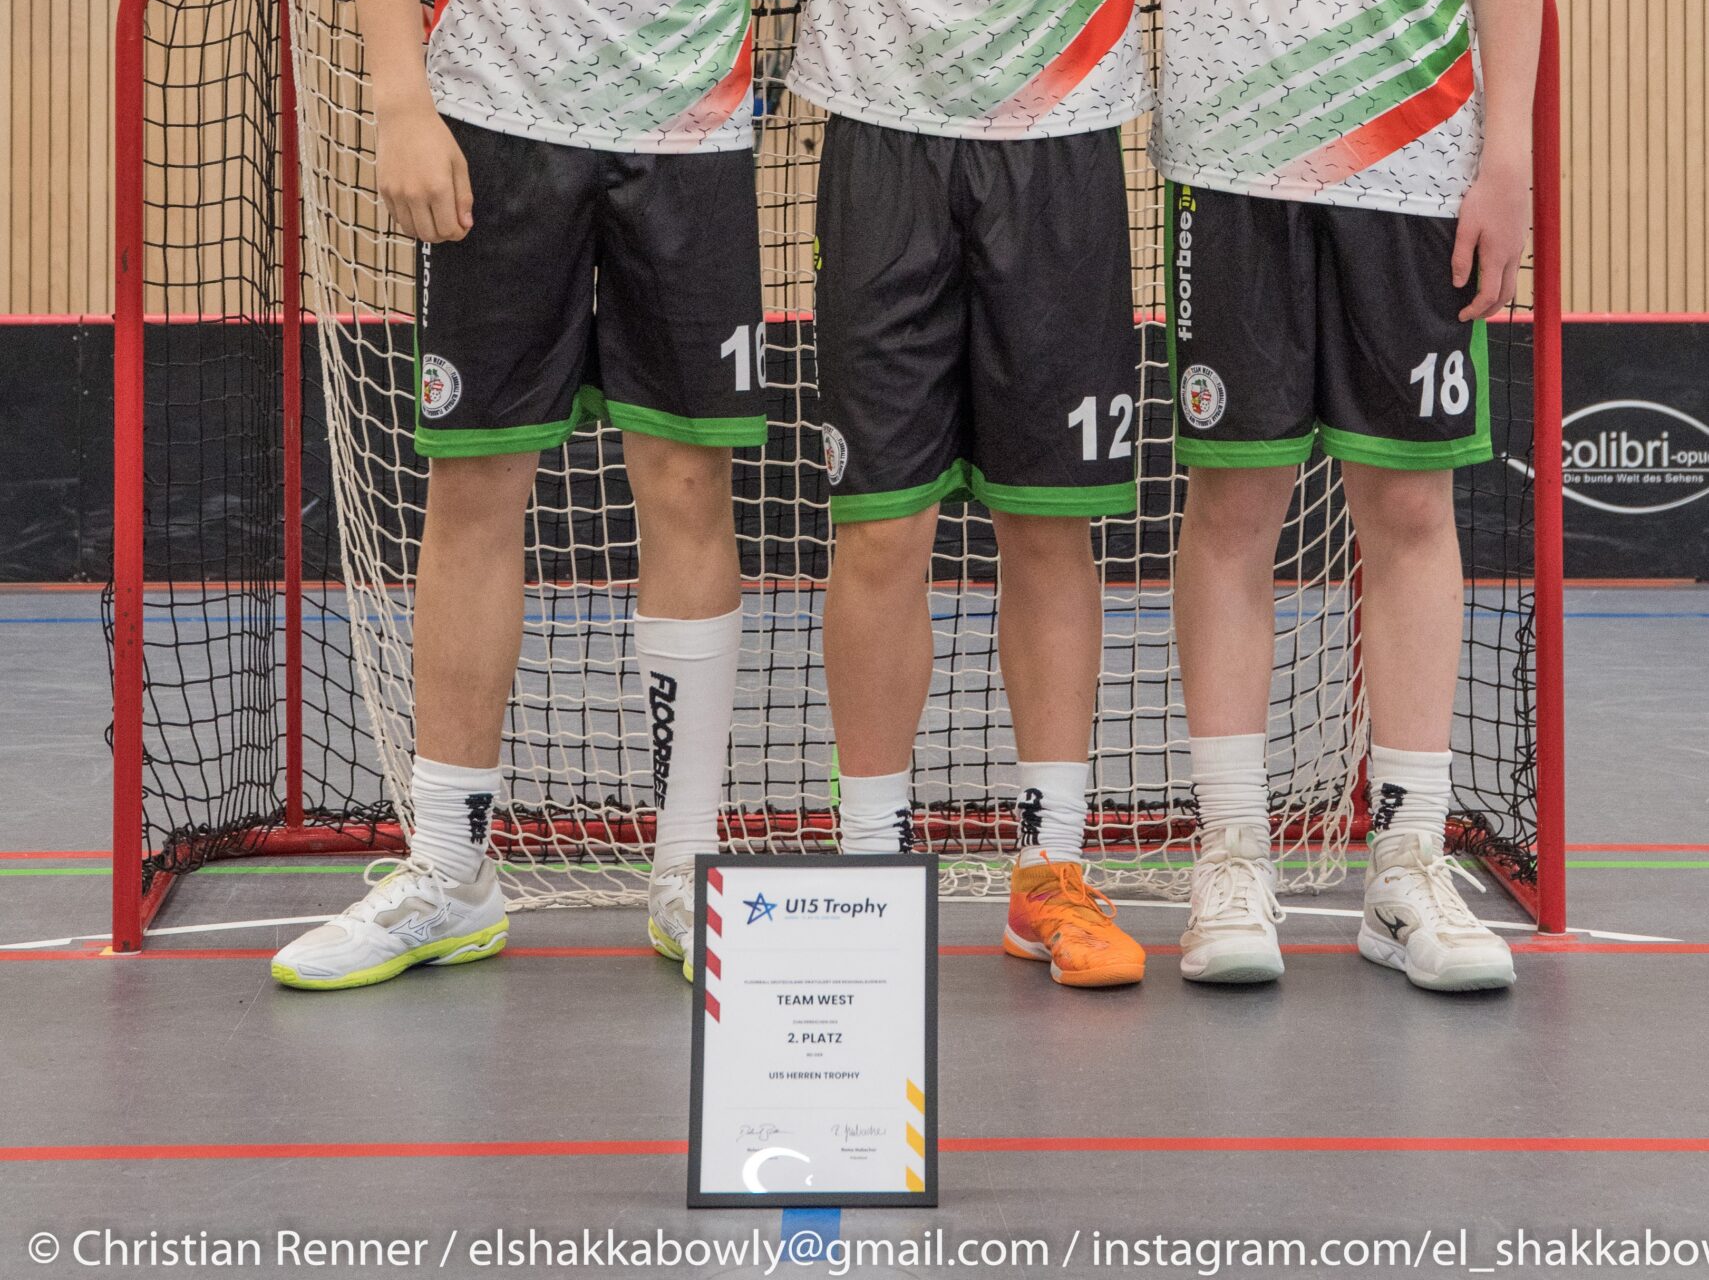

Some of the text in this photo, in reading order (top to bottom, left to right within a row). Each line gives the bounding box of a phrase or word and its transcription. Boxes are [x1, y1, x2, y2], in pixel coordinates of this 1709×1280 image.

[1176, 211, 1193, 342] floorbee
[1409, 349, 1470, 417] 18
[1068, 393, 1133, 460] 12
[1563, 473, 1704, 483] Die bunte Welt des Sehens
[785, 897, 888, 918] U15 Trophy
[777, 994, 855, 1006] TEAM WEST
[787, 1032, 843, 1044] 2. PLATZ
[768, 1071, 861, 1080] U15 HERREN TROPHY
